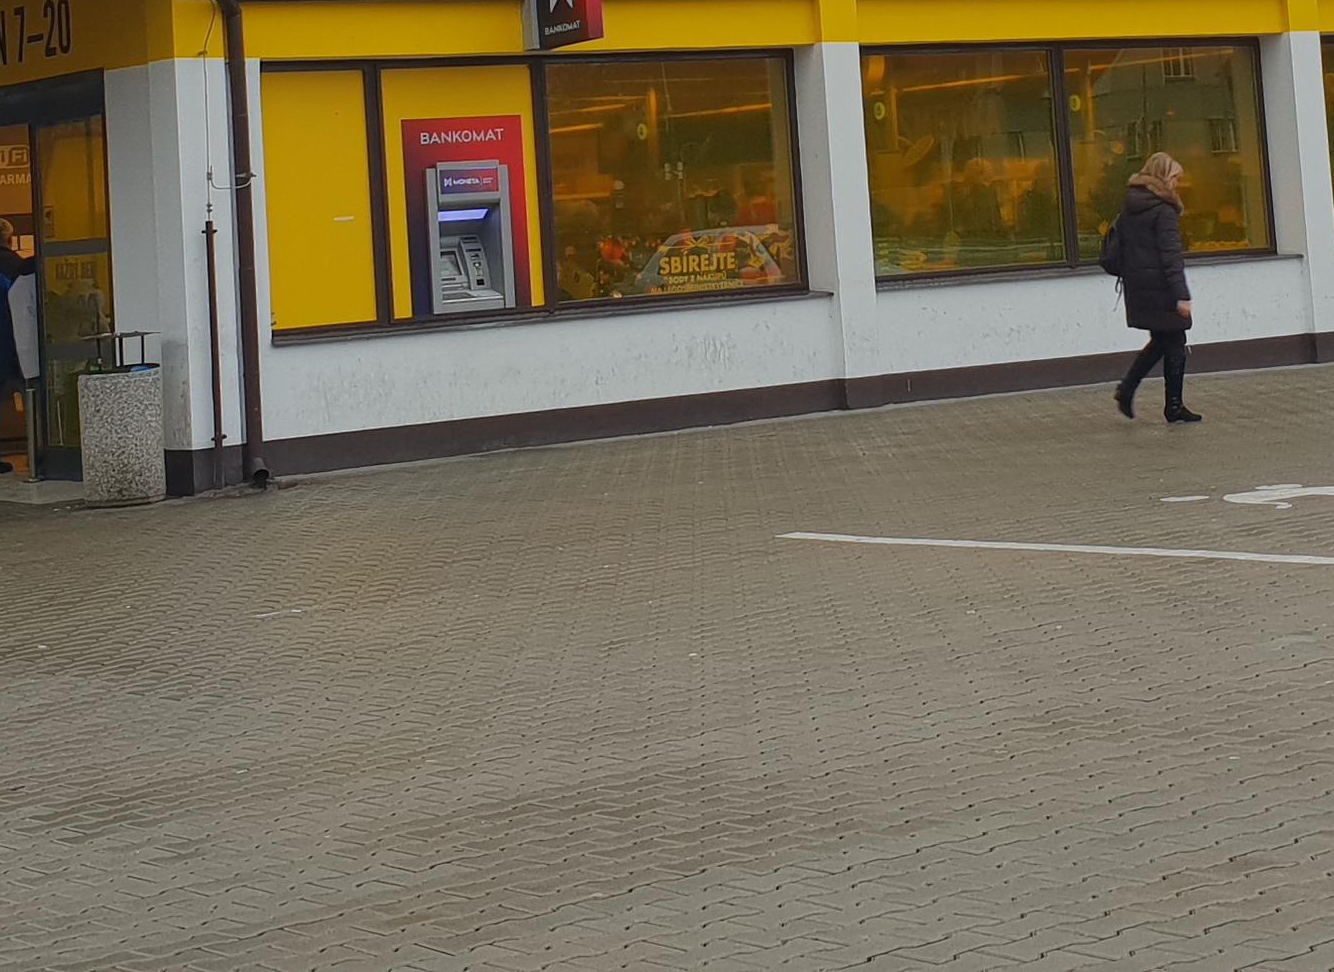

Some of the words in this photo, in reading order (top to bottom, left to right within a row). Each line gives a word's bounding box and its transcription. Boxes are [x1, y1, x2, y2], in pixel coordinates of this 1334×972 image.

[544, 20, 581, 36] BANKOMAT
[420, 128, 505, 145] BANKOMAT
[658, 251, 737, 276] SBÍREJTE
